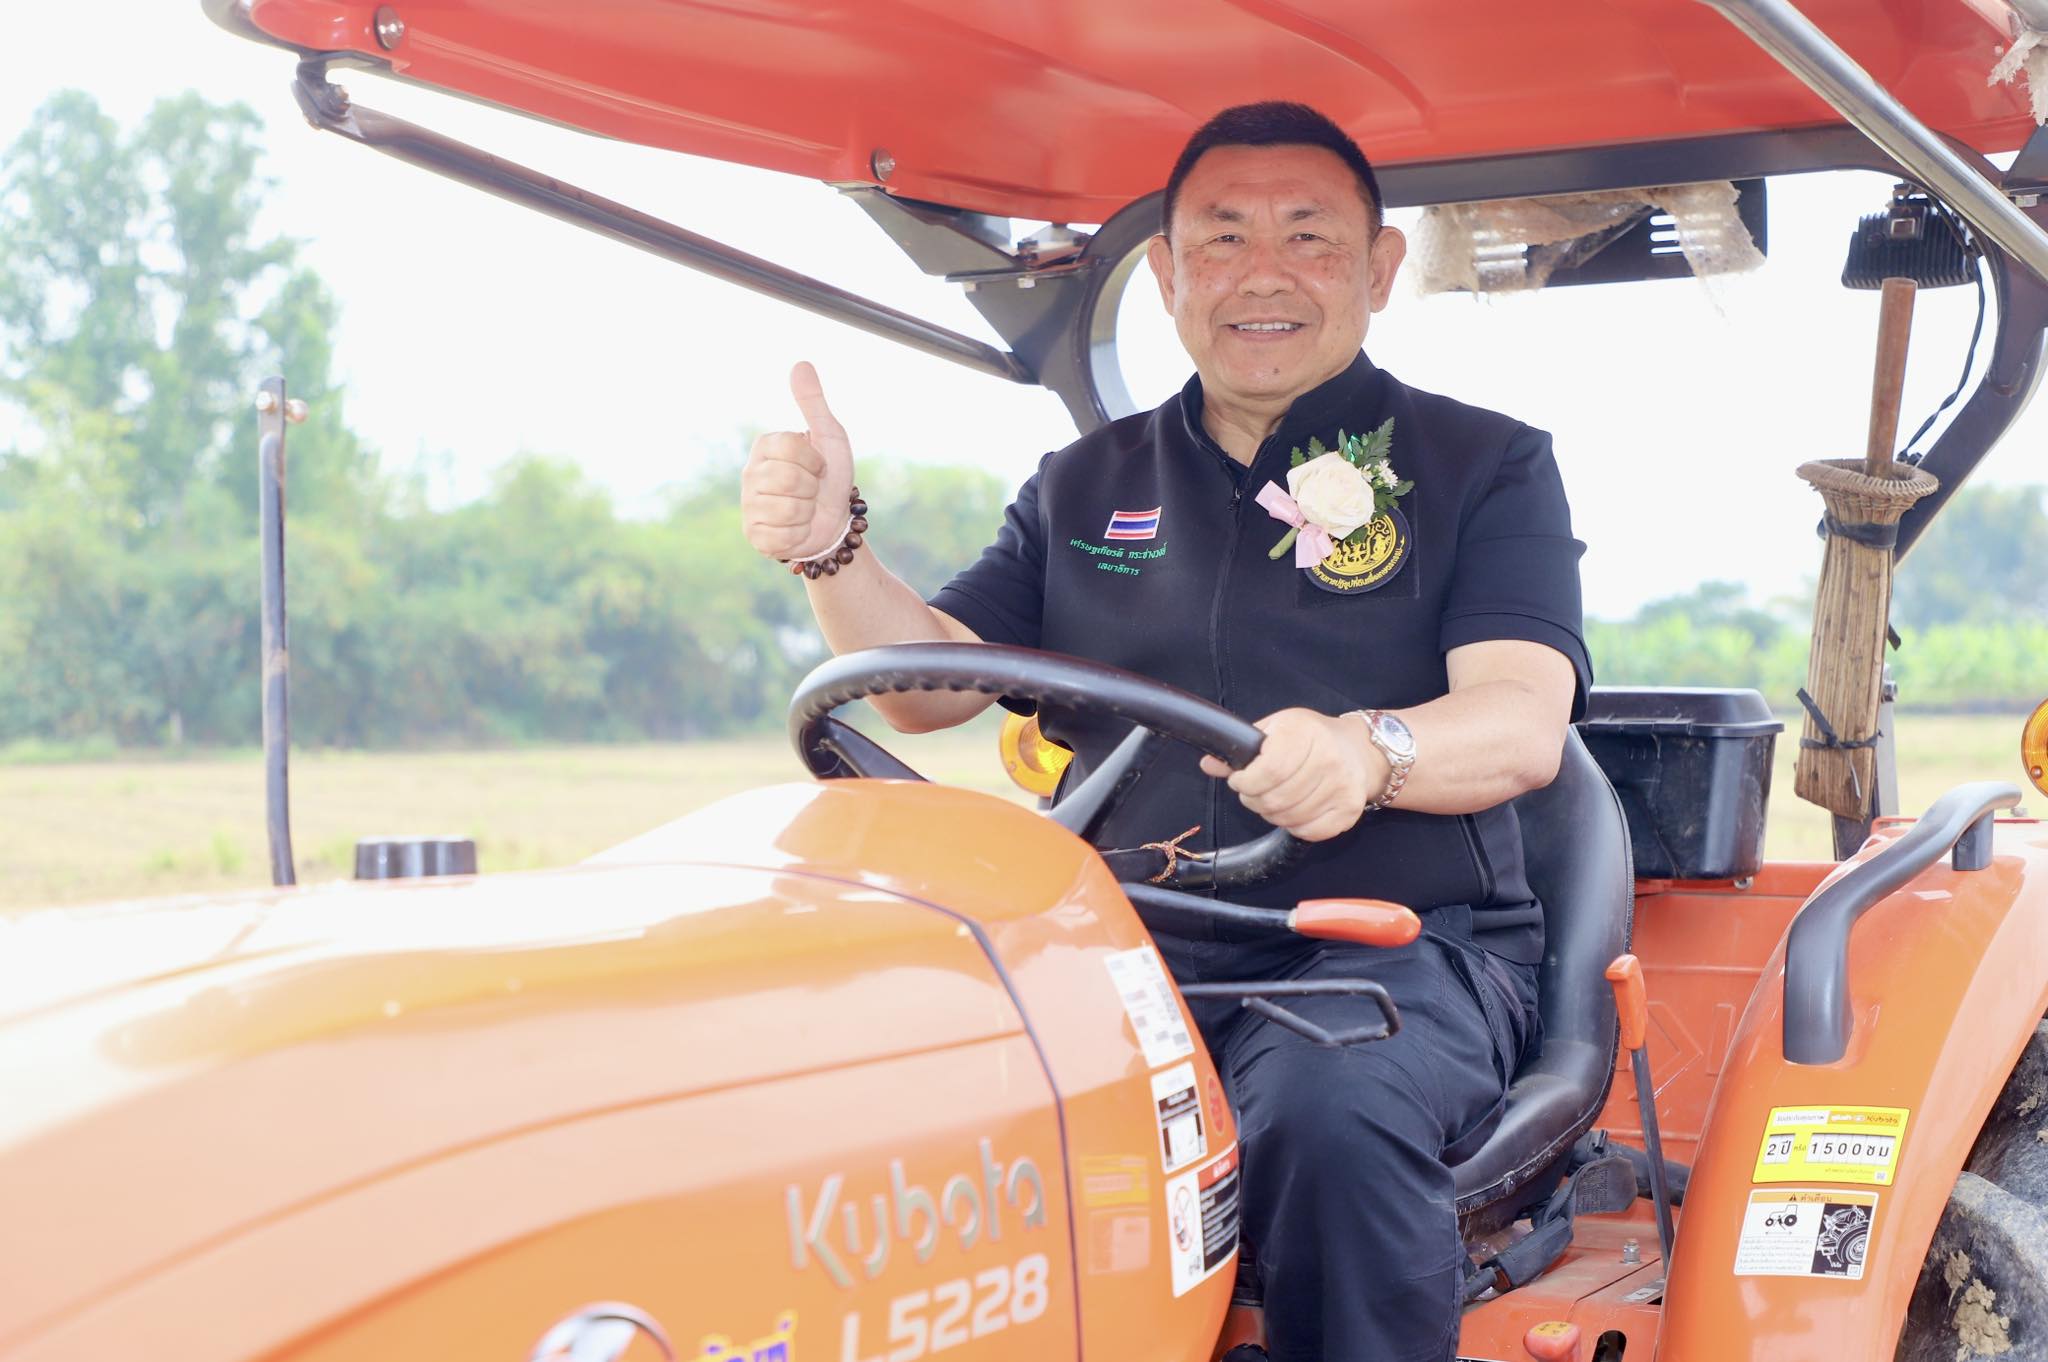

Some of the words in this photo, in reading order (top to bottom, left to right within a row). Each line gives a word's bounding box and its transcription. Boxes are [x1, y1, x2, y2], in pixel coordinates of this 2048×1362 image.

[1097, 562, 1141, 576] เลขาธิการ
[786, 1136, 1048, 1288] Kubota
[841, 1253, 1049, 1362] L5228
